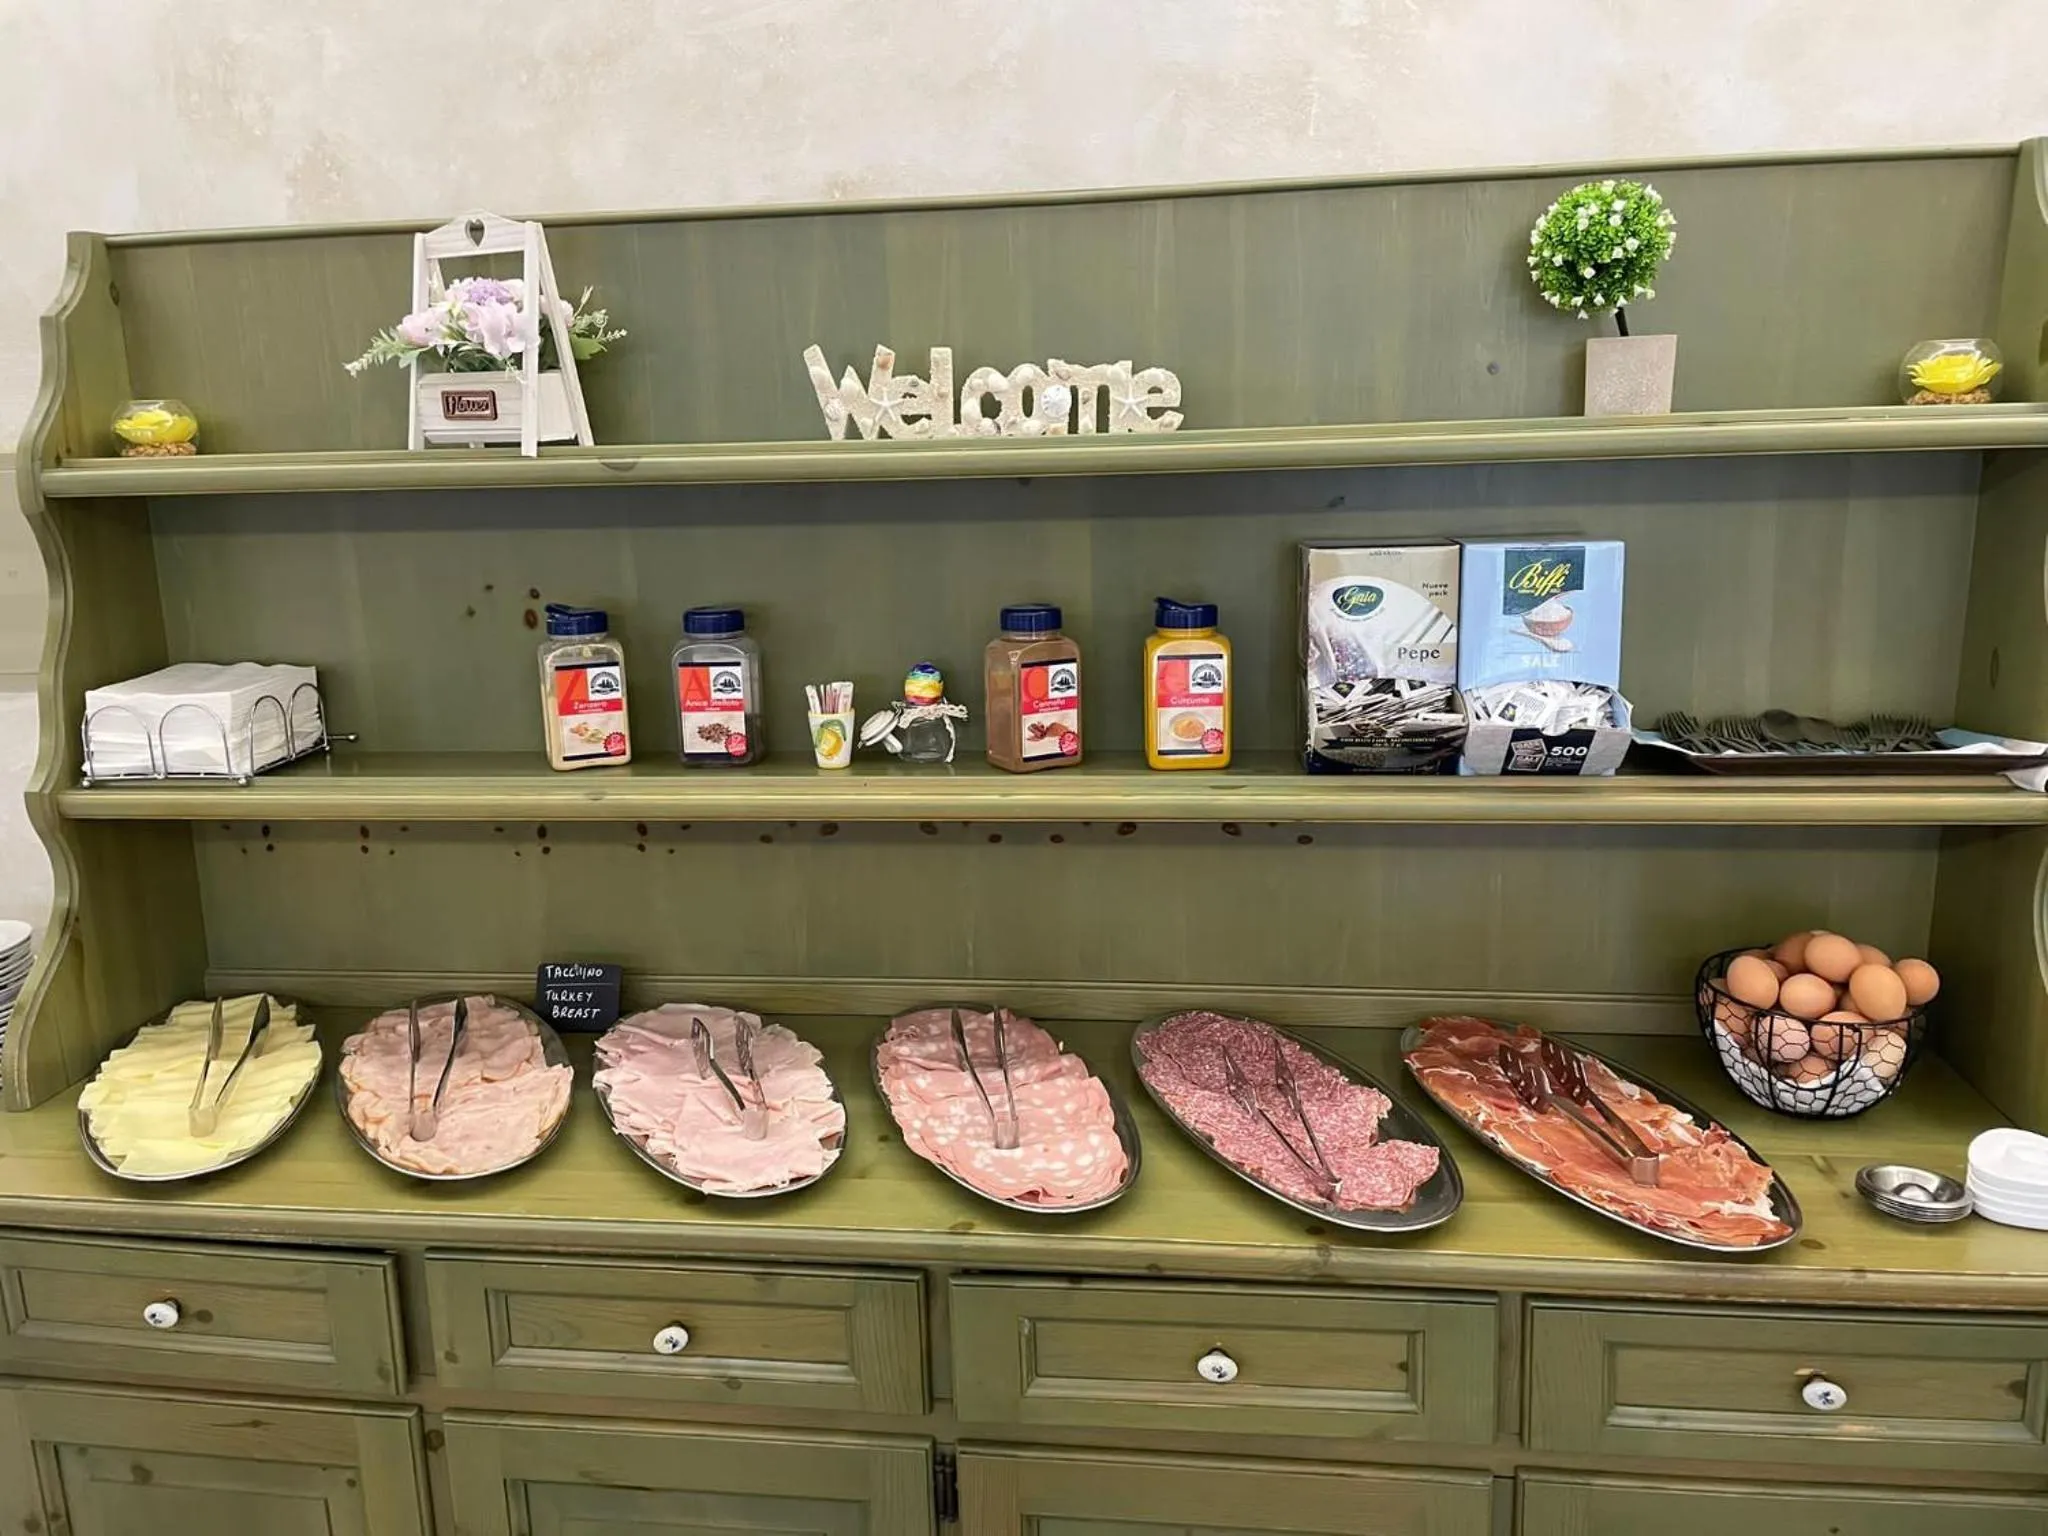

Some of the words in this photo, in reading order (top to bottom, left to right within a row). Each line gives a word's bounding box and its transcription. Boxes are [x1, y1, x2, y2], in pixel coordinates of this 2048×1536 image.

[803, 344, 1184, 440] Welcome
[1509, 559, 1571, 596] Biffi
[1338, 586, 1377, 611] Gaia
[1397, 647, 1441, 662] Pepe
[1521, 654, 1561, 668] SALE
[1170, 696, 1210, 705] Curcuma
[1550, 746, 1588, 756] 500
[545, 989, 594, 1003] TURKEY
[552, 1005, 601, 1019] BREAST
